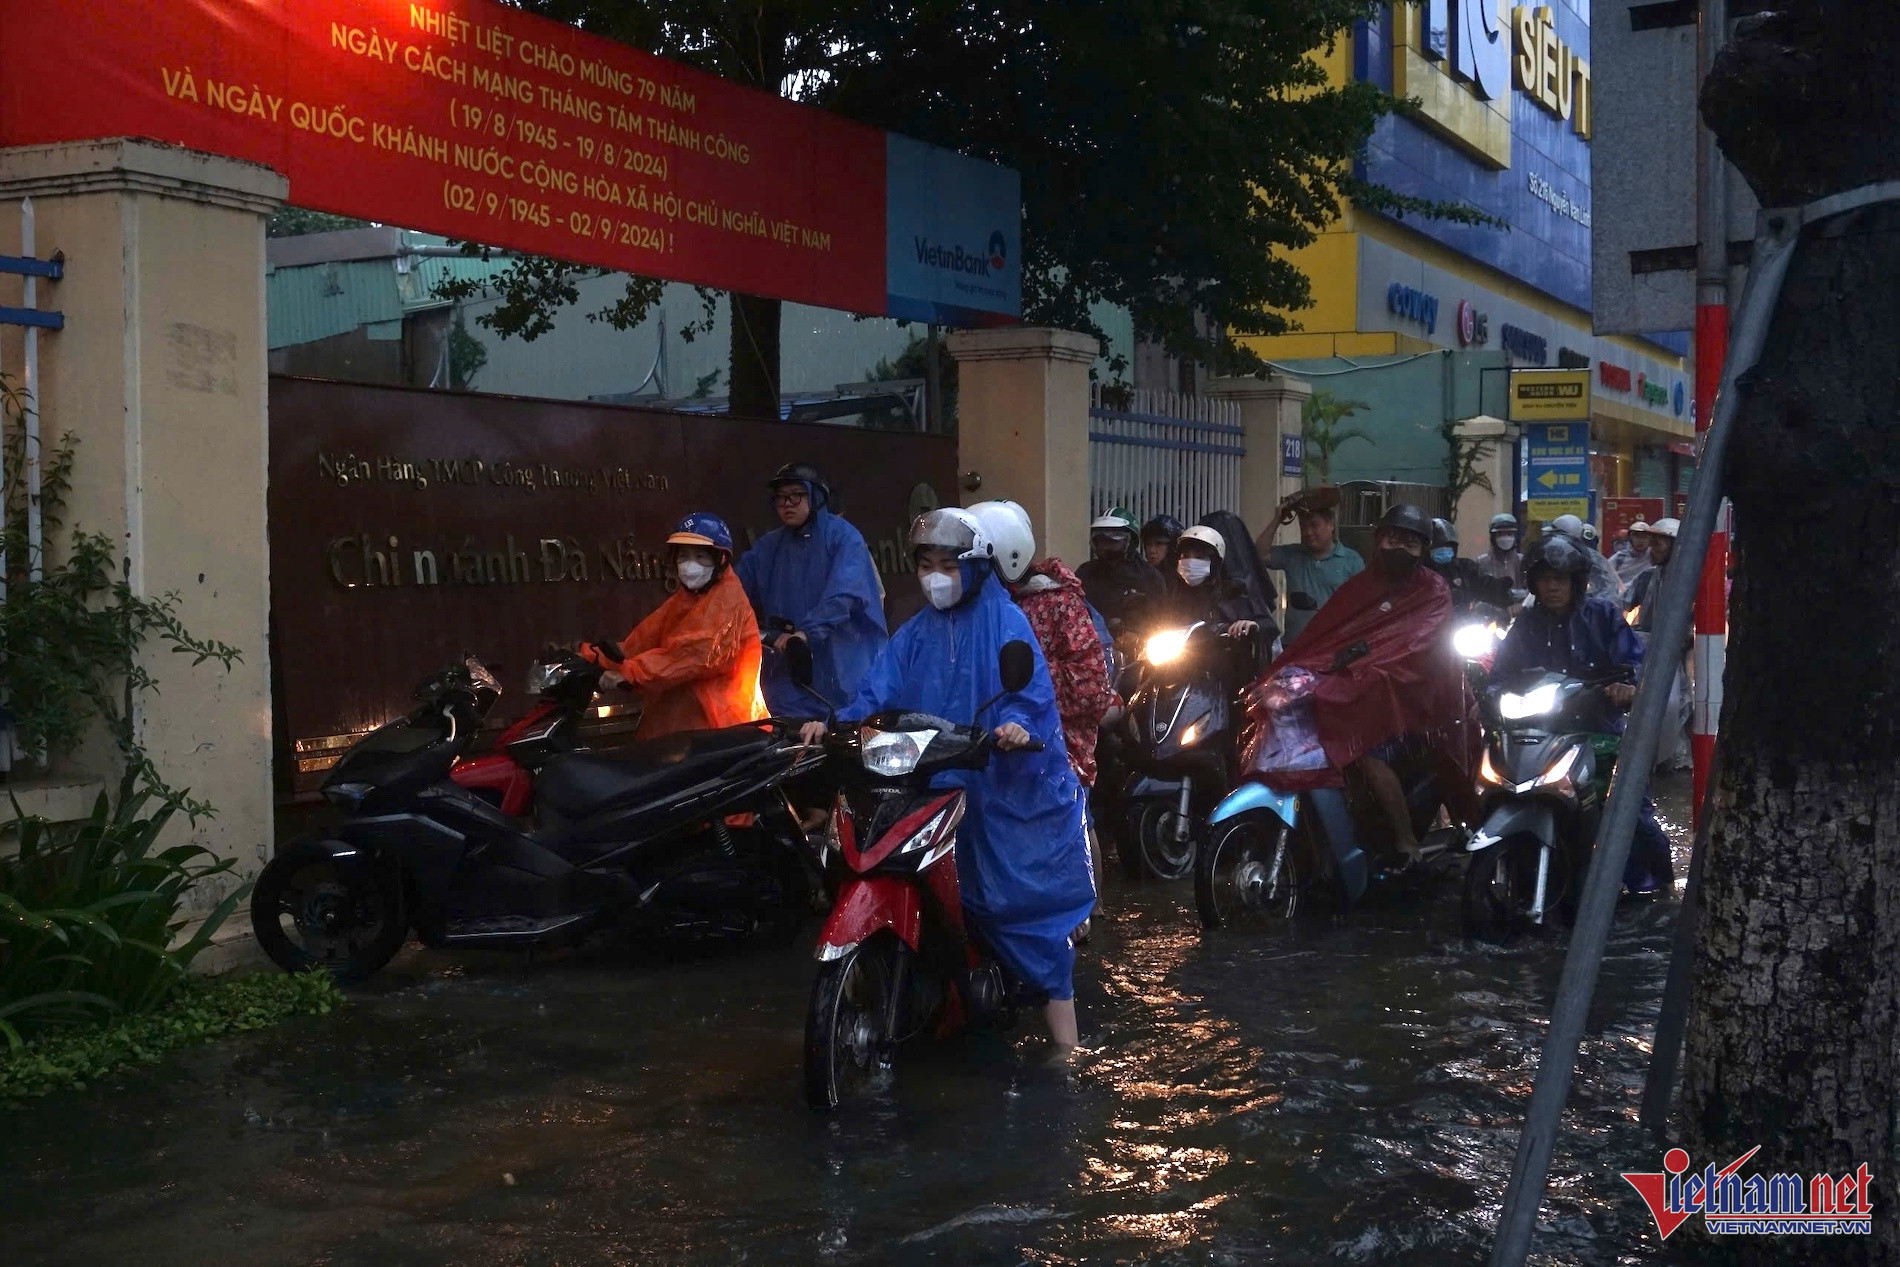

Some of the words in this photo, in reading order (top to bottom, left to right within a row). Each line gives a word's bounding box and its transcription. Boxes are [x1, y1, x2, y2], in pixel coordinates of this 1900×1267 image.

[410, 3, 469, 46] NHIỆT
[476, 26, 513, 57] LIỆT
[519, 35, 575, 77] CHÀO
[580, 58, 633, 96] MỪNG
[638, 77, 655, 101] 79
[660, 81, 696, 115] NĂM
[330, 21, 398, 66] NGÀY
[404, 43, 466, 87] CÁCH
[473, 70, 534, 103] MẠNG
[539, 84, 602, 124] THÁNG
[607, 102, 643, 135] TÁM
[647, 116, 700, 152] THÀNH
[704, 132, 749, 165] CÔNG
[161, 66, 199, 104] VÀ
[206, 79, 283, 123] NGÀY
[290, 100, 365, 143] QUỐC
[372, 121, 447, 165] KHÁNH
[454, 146, 514, 179] NƯỚC
[520, 160, 578, 194] CỘNG
[583, 173, 622, 205] HÒA
[626, 184, 649, 211] XÃ
[653, 190, 682, 223] HỘI
[685, 199, 718, 227] CHỦ
[721, 209, 768, 238] NGHĨA
[770, 219, 798, 248] VIỆT
[802, 228, 831, 251] NAM
[576, 136, 668, 182] 19/8/2024)
[443, 179, 550, 228] (02/9/1945
[915, 235, 991, 278] VietinBank
[317, 452, 371, 488] Ngân
[377, 455, 428, 490] Hàng
[1285, 438, 1301, 459] 218
[328, 533, 401, 588] Chi
[540, 535, 588, 583] Đà
